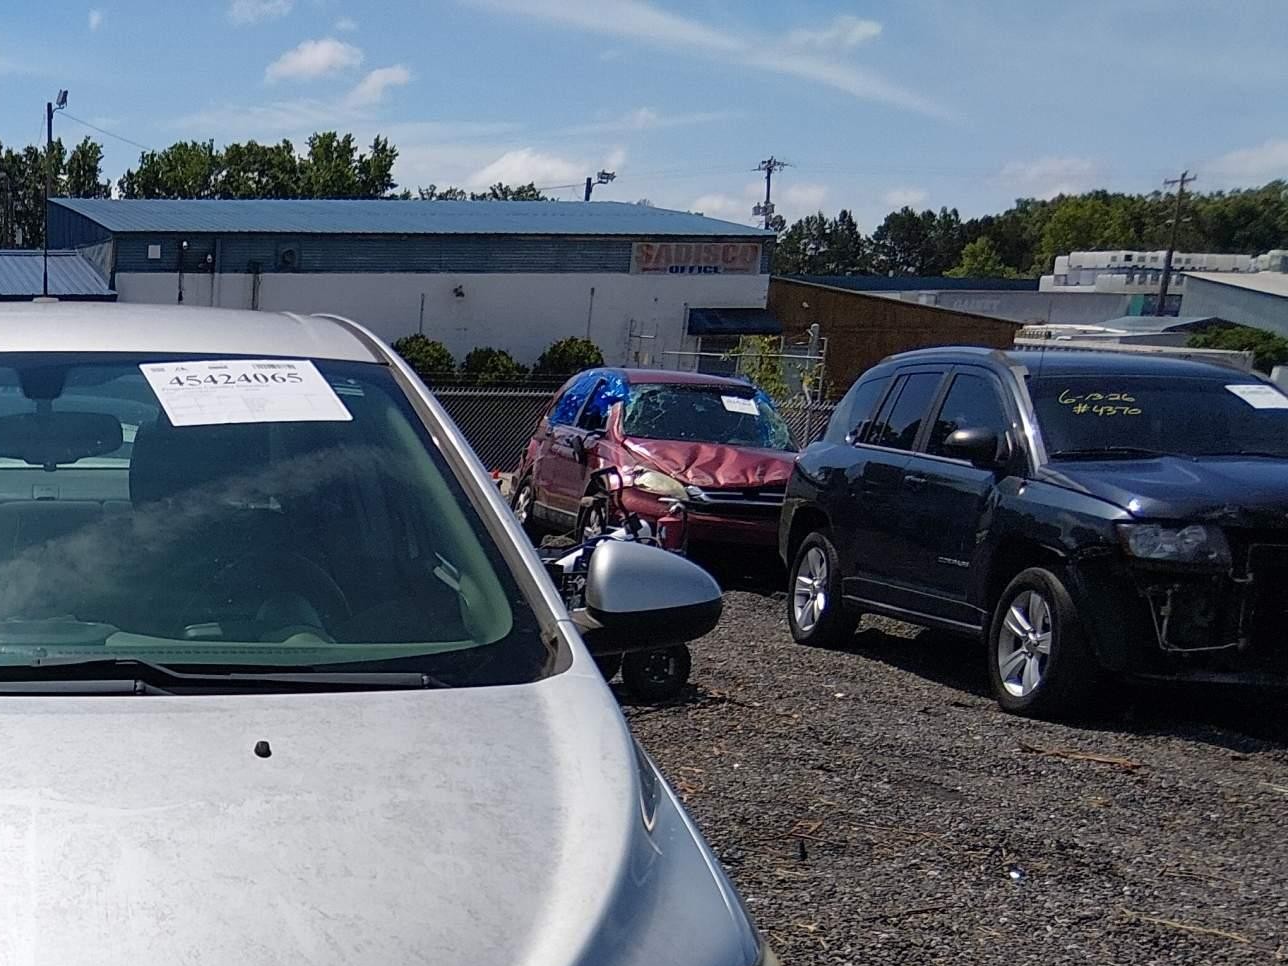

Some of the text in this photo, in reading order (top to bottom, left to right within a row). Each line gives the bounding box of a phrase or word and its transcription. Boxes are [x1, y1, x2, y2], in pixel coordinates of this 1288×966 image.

[636, 243, 759, 264] SADISCO
[668, 265, 722, 274] OFFICE
[170, 372, 303, 387] 45424065
